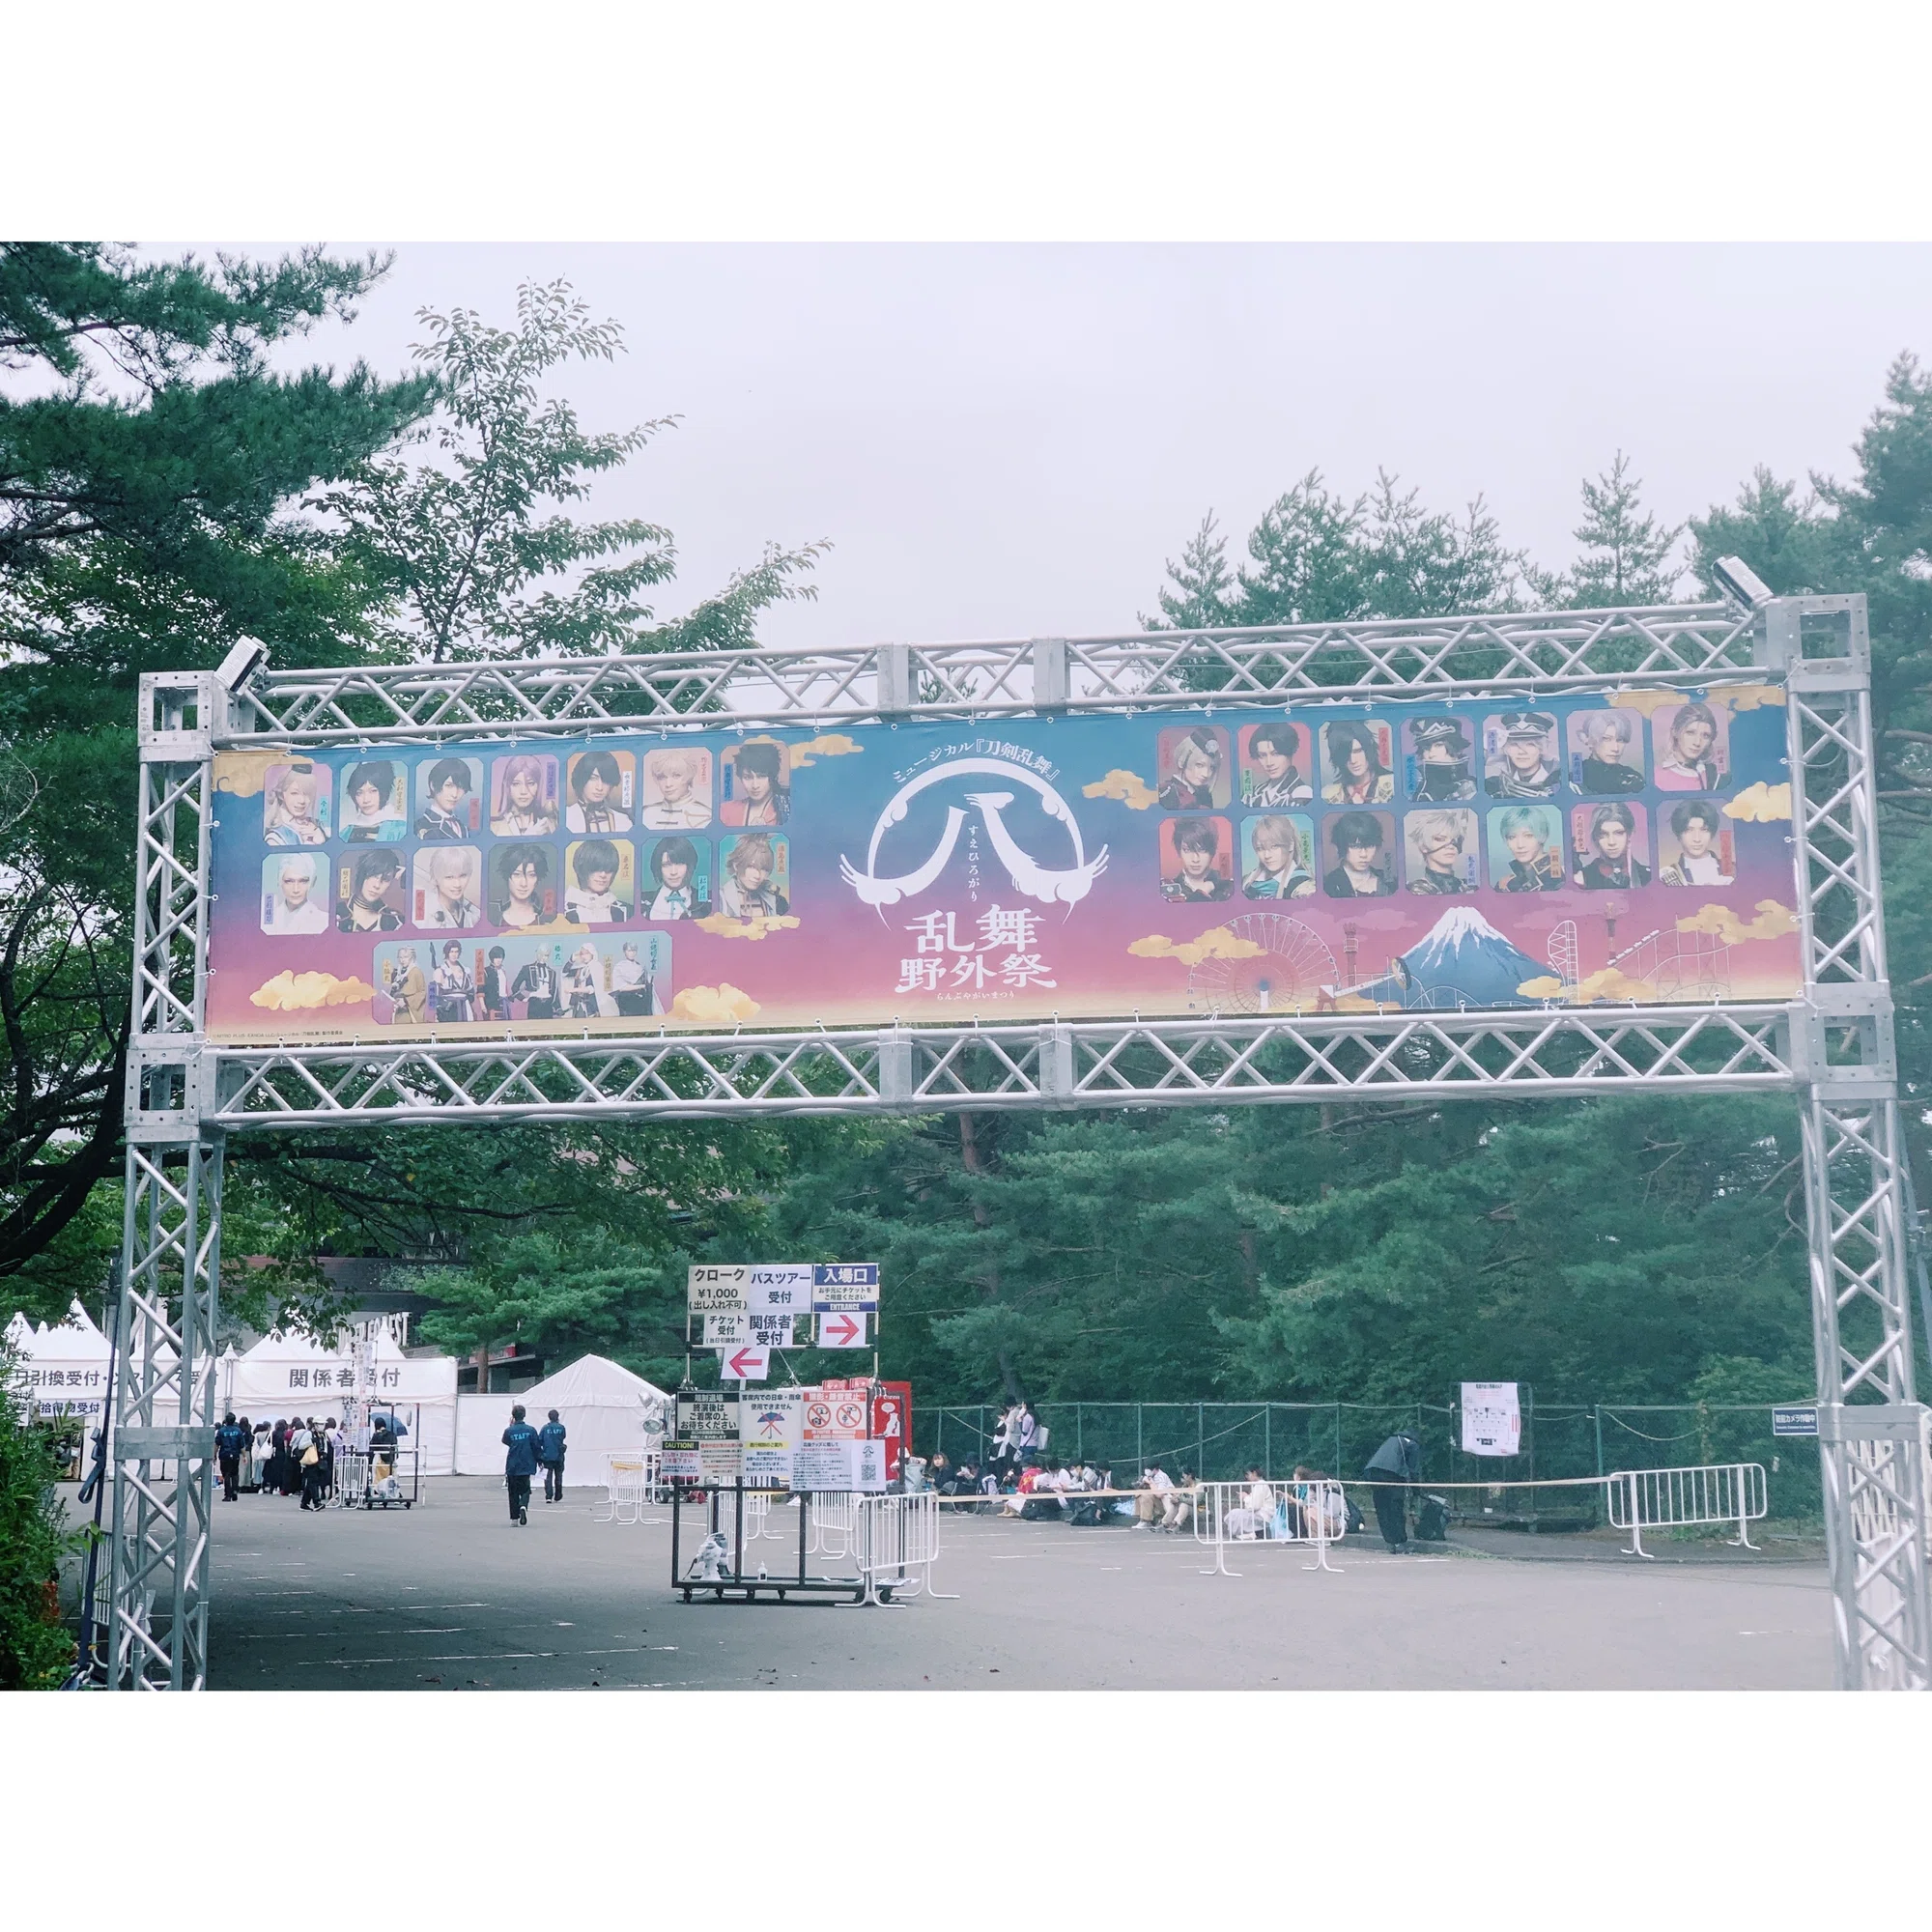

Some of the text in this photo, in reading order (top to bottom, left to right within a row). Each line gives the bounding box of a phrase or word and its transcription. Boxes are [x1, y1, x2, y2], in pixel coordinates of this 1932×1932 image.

[894, 738, 1061, 782] ミュージカル『刀剣乱舞』
[968, 824, 980, 902] すえひろがり
[903, 904, 1046, 953] 乱舞
[895, 953, 1058, 994] 野外祭
[937, 990, 1014, 1001] らんぶやがいまつり
[694, 1268, 745, 1282] クローク
[751, 1272, 811, 1284] バスツアー
[824, 1267, 868, 1284] 入場口
[697, 1289, 739, 1299] ¥1,000
[768, 1291, 792, 1304] 受付
[689, 1300, 748, 1310] (出し入れ不可)
[829, 1302, 861, 1311] ENTRANCE
[709, 1315, 745, 1324] チケット
[749, 1315, 792, 1329] 関係者
[717, 1325, 735, 1335] 受付
[755, 1331, 784, 1346] 受付
[680, 1421, 737, 1430] お待ちください
